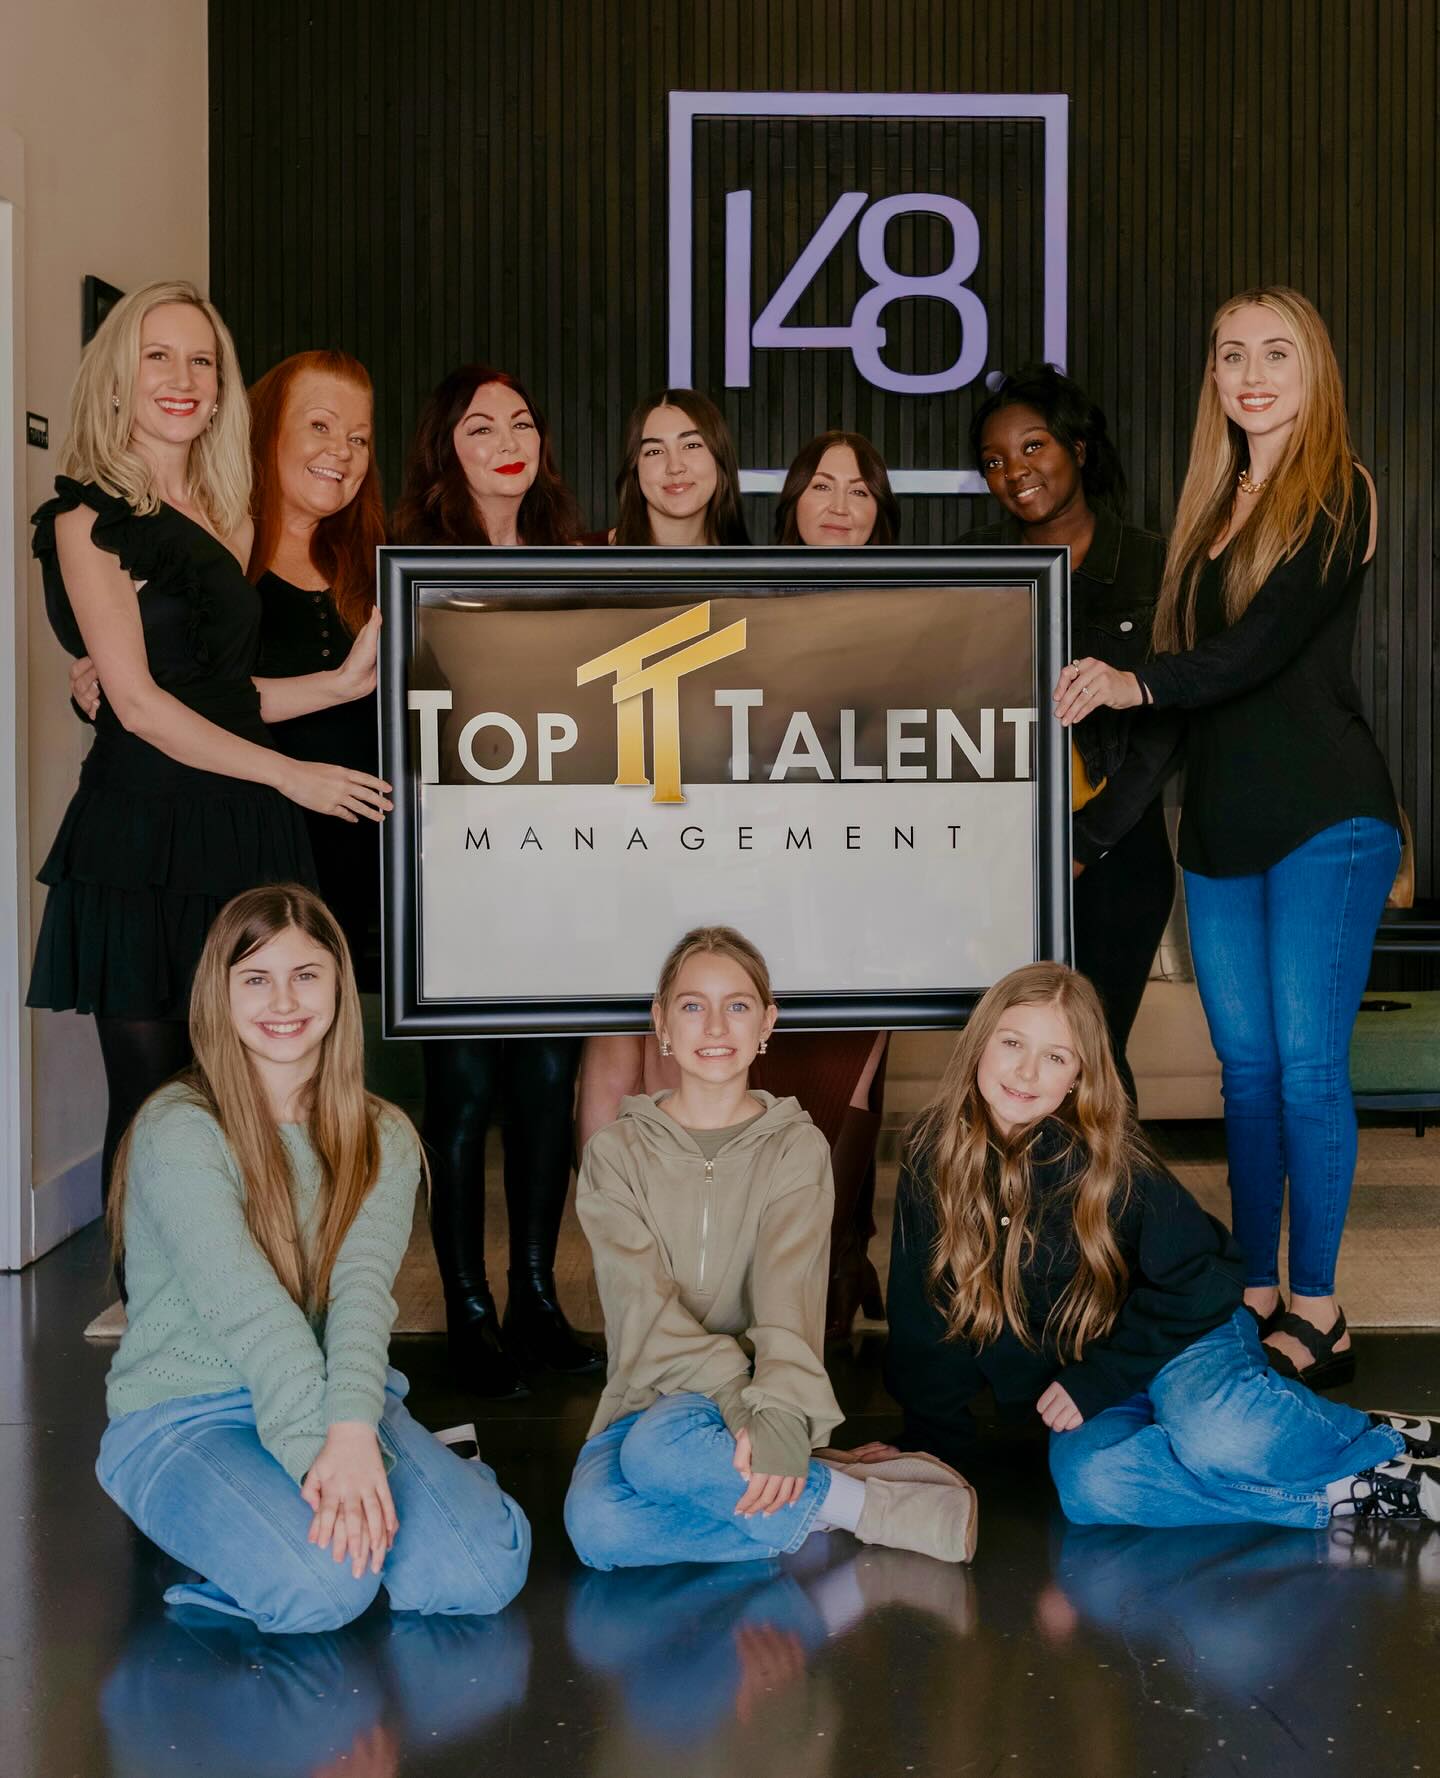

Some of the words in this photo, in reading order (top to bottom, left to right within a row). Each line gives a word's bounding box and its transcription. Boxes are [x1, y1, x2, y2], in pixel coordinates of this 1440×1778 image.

[408, 690, 578, 784] TOP
[714, 689, 1038, 781] TALENT
[465, 825, 961, 851] MANAGEMENT
